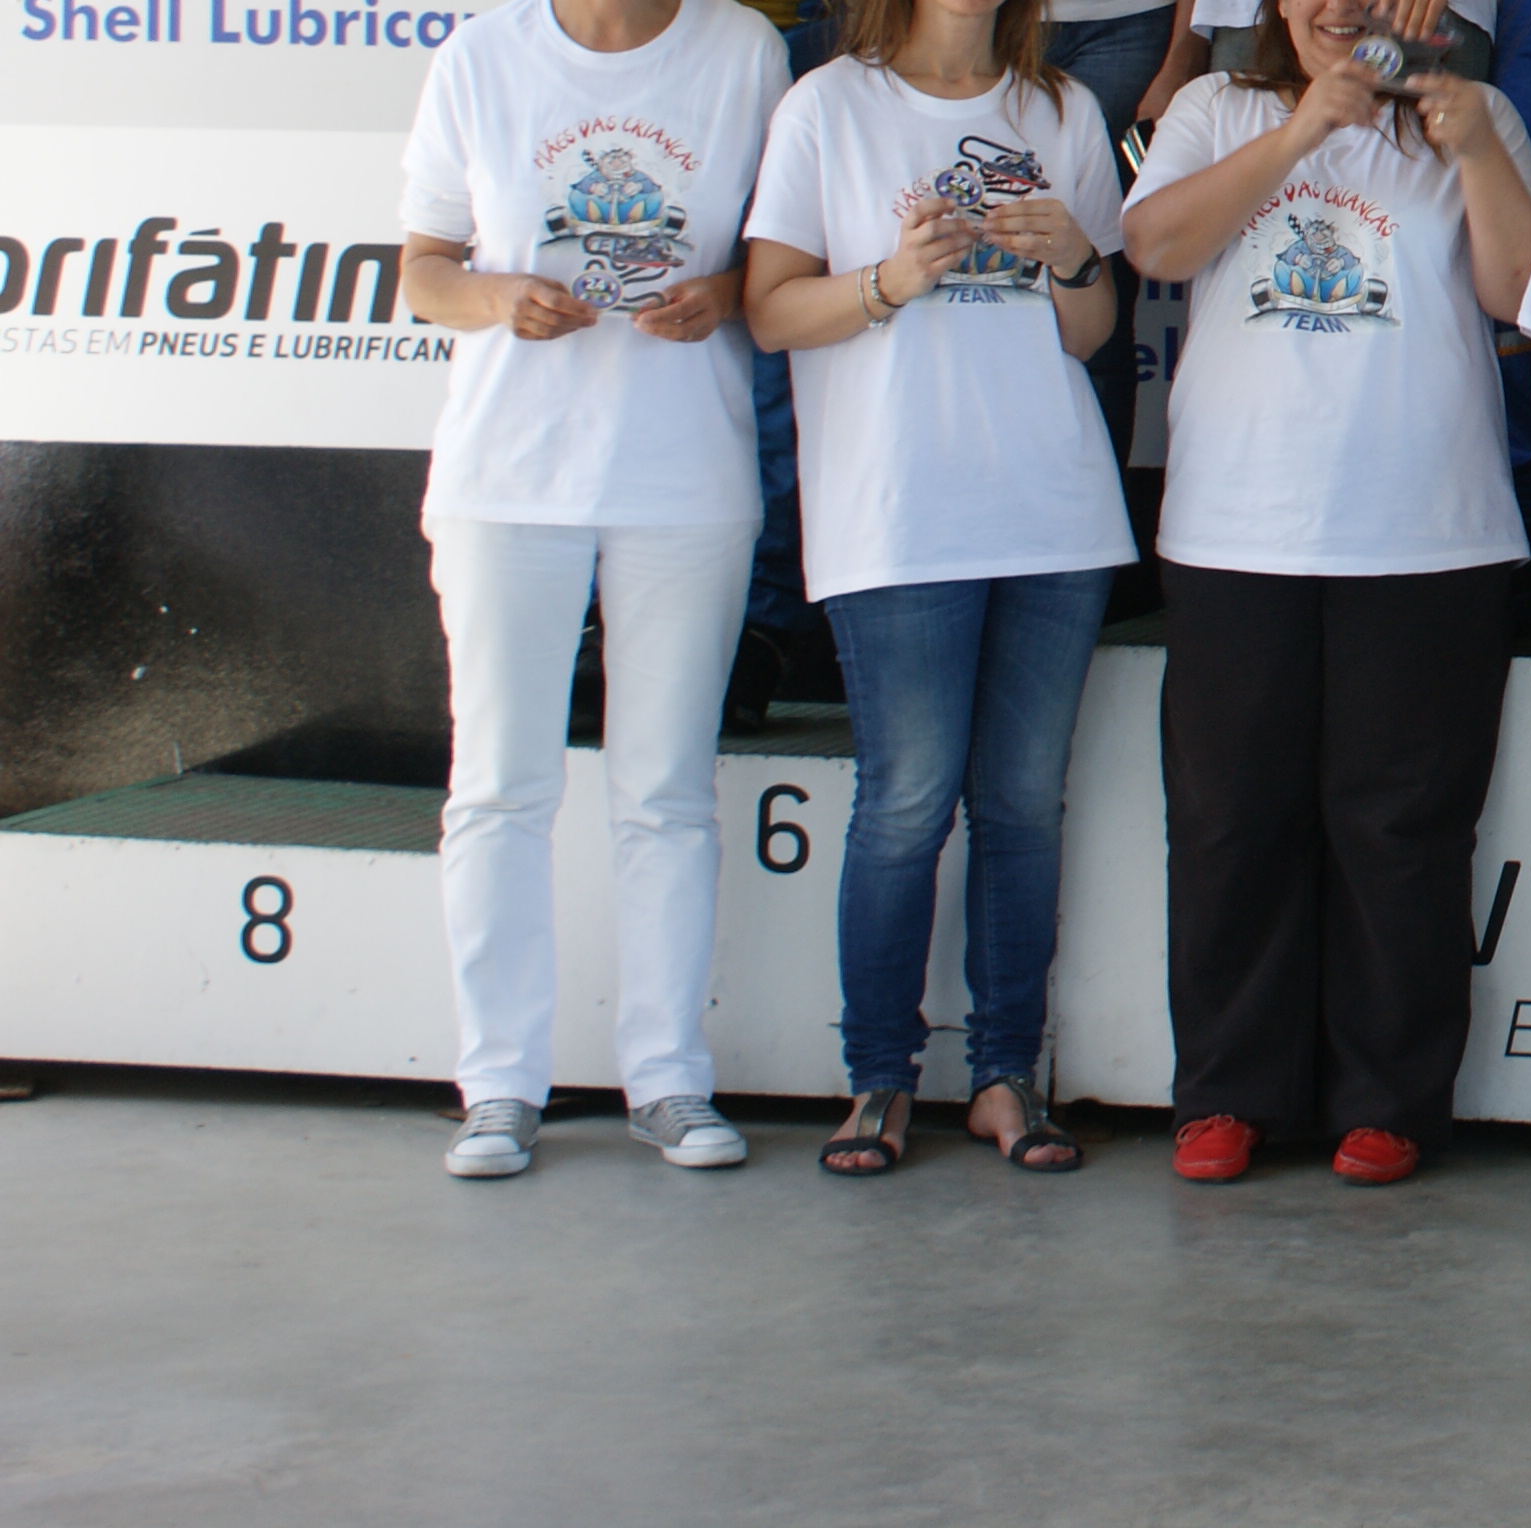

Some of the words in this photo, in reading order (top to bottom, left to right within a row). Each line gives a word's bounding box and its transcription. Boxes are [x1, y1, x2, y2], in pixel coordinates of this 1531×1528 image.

[578, 115, 617, 139] DAS
[1283, 180, 1321, 203] DAS
[947, 286, 1006, 304] TEAM
[1282, 311, 1352, 334] TEAM
[86, 329, 132, 355] EM
[138, 331, 239, 358] PNEUS
[247, 334, 267, 358] E
[754, 783, 813, 875] 6
[237, 874, 296, 965] 8
